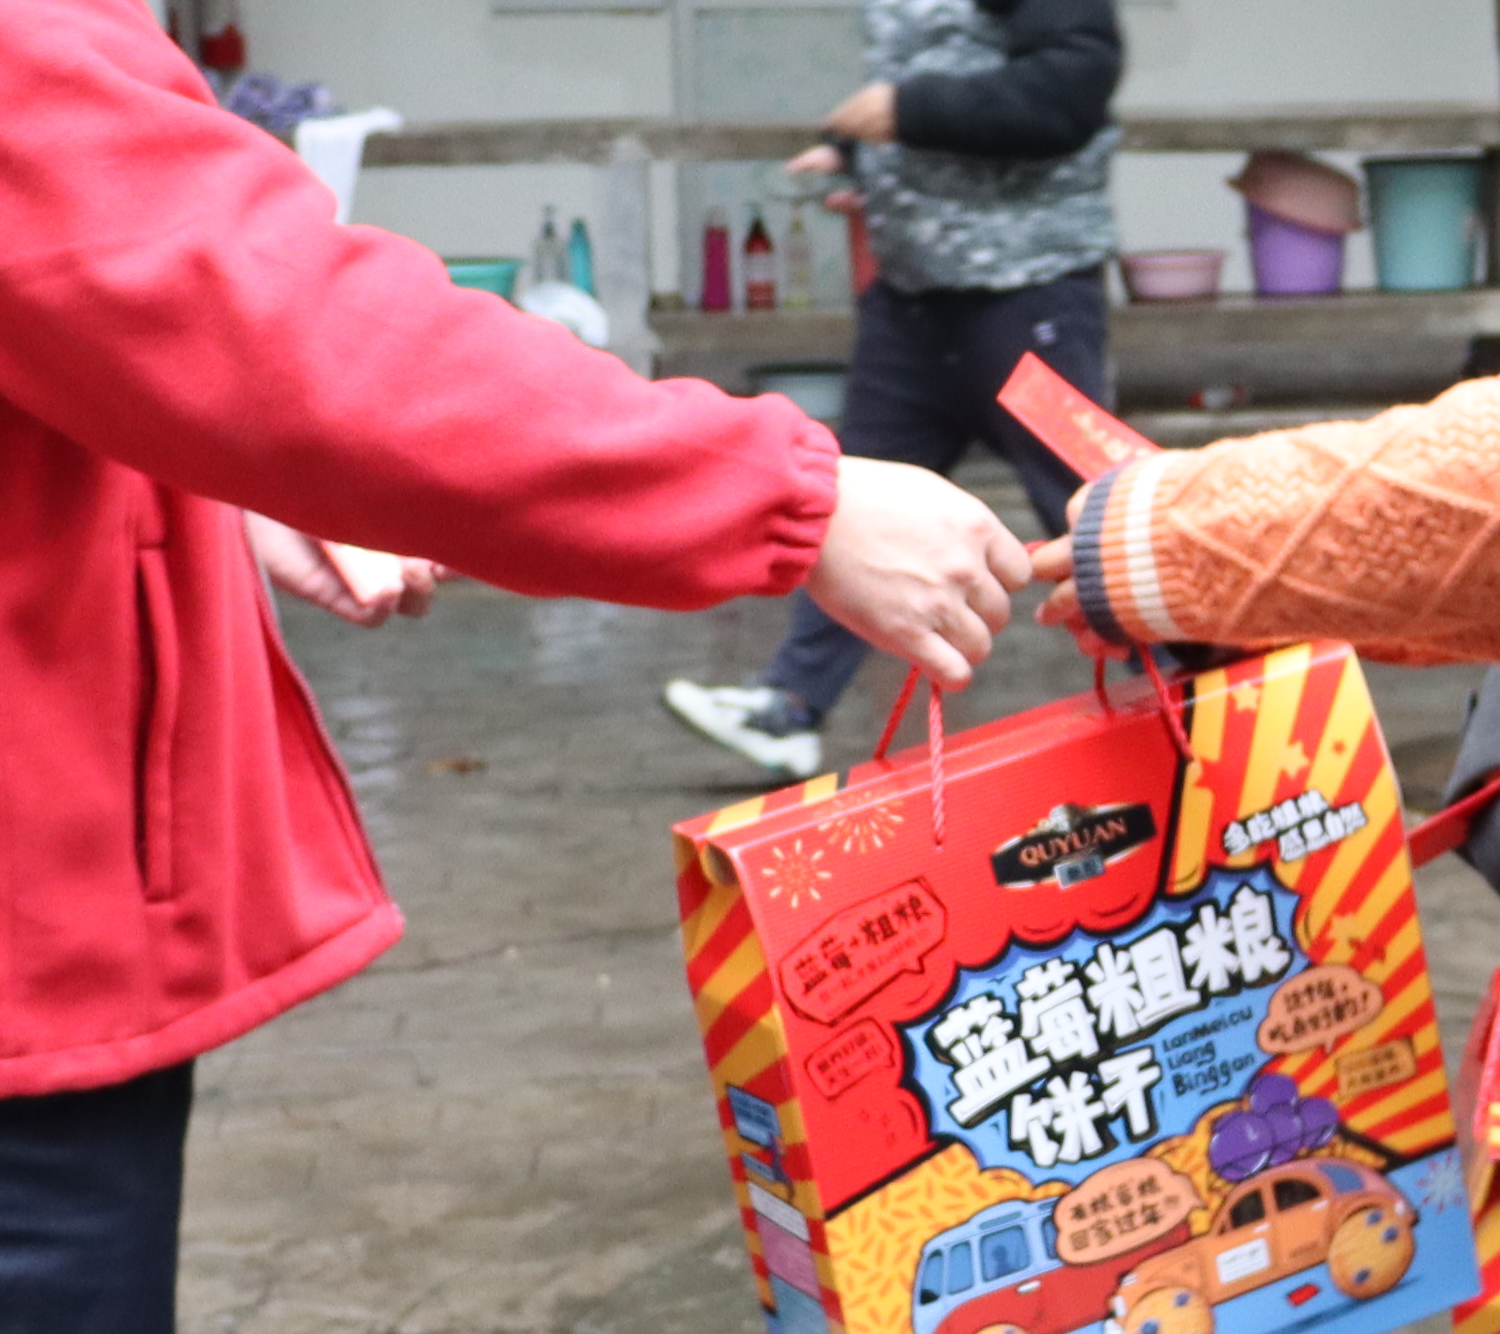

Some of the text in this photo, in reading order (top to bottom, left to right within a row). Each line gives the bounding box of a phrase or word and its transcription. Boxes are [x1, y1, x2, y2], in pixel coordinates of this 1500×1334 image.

[1019, 818, 1128, 867] QUYUAN
[933, 884, 1290, 1125] 蓝莓粗粮
[1167, 1041, 1217, 1071] Liang
[1172, 1053, 1256, 1097] Binggan
[1010, 1047, 1160, 1167] 饼干
